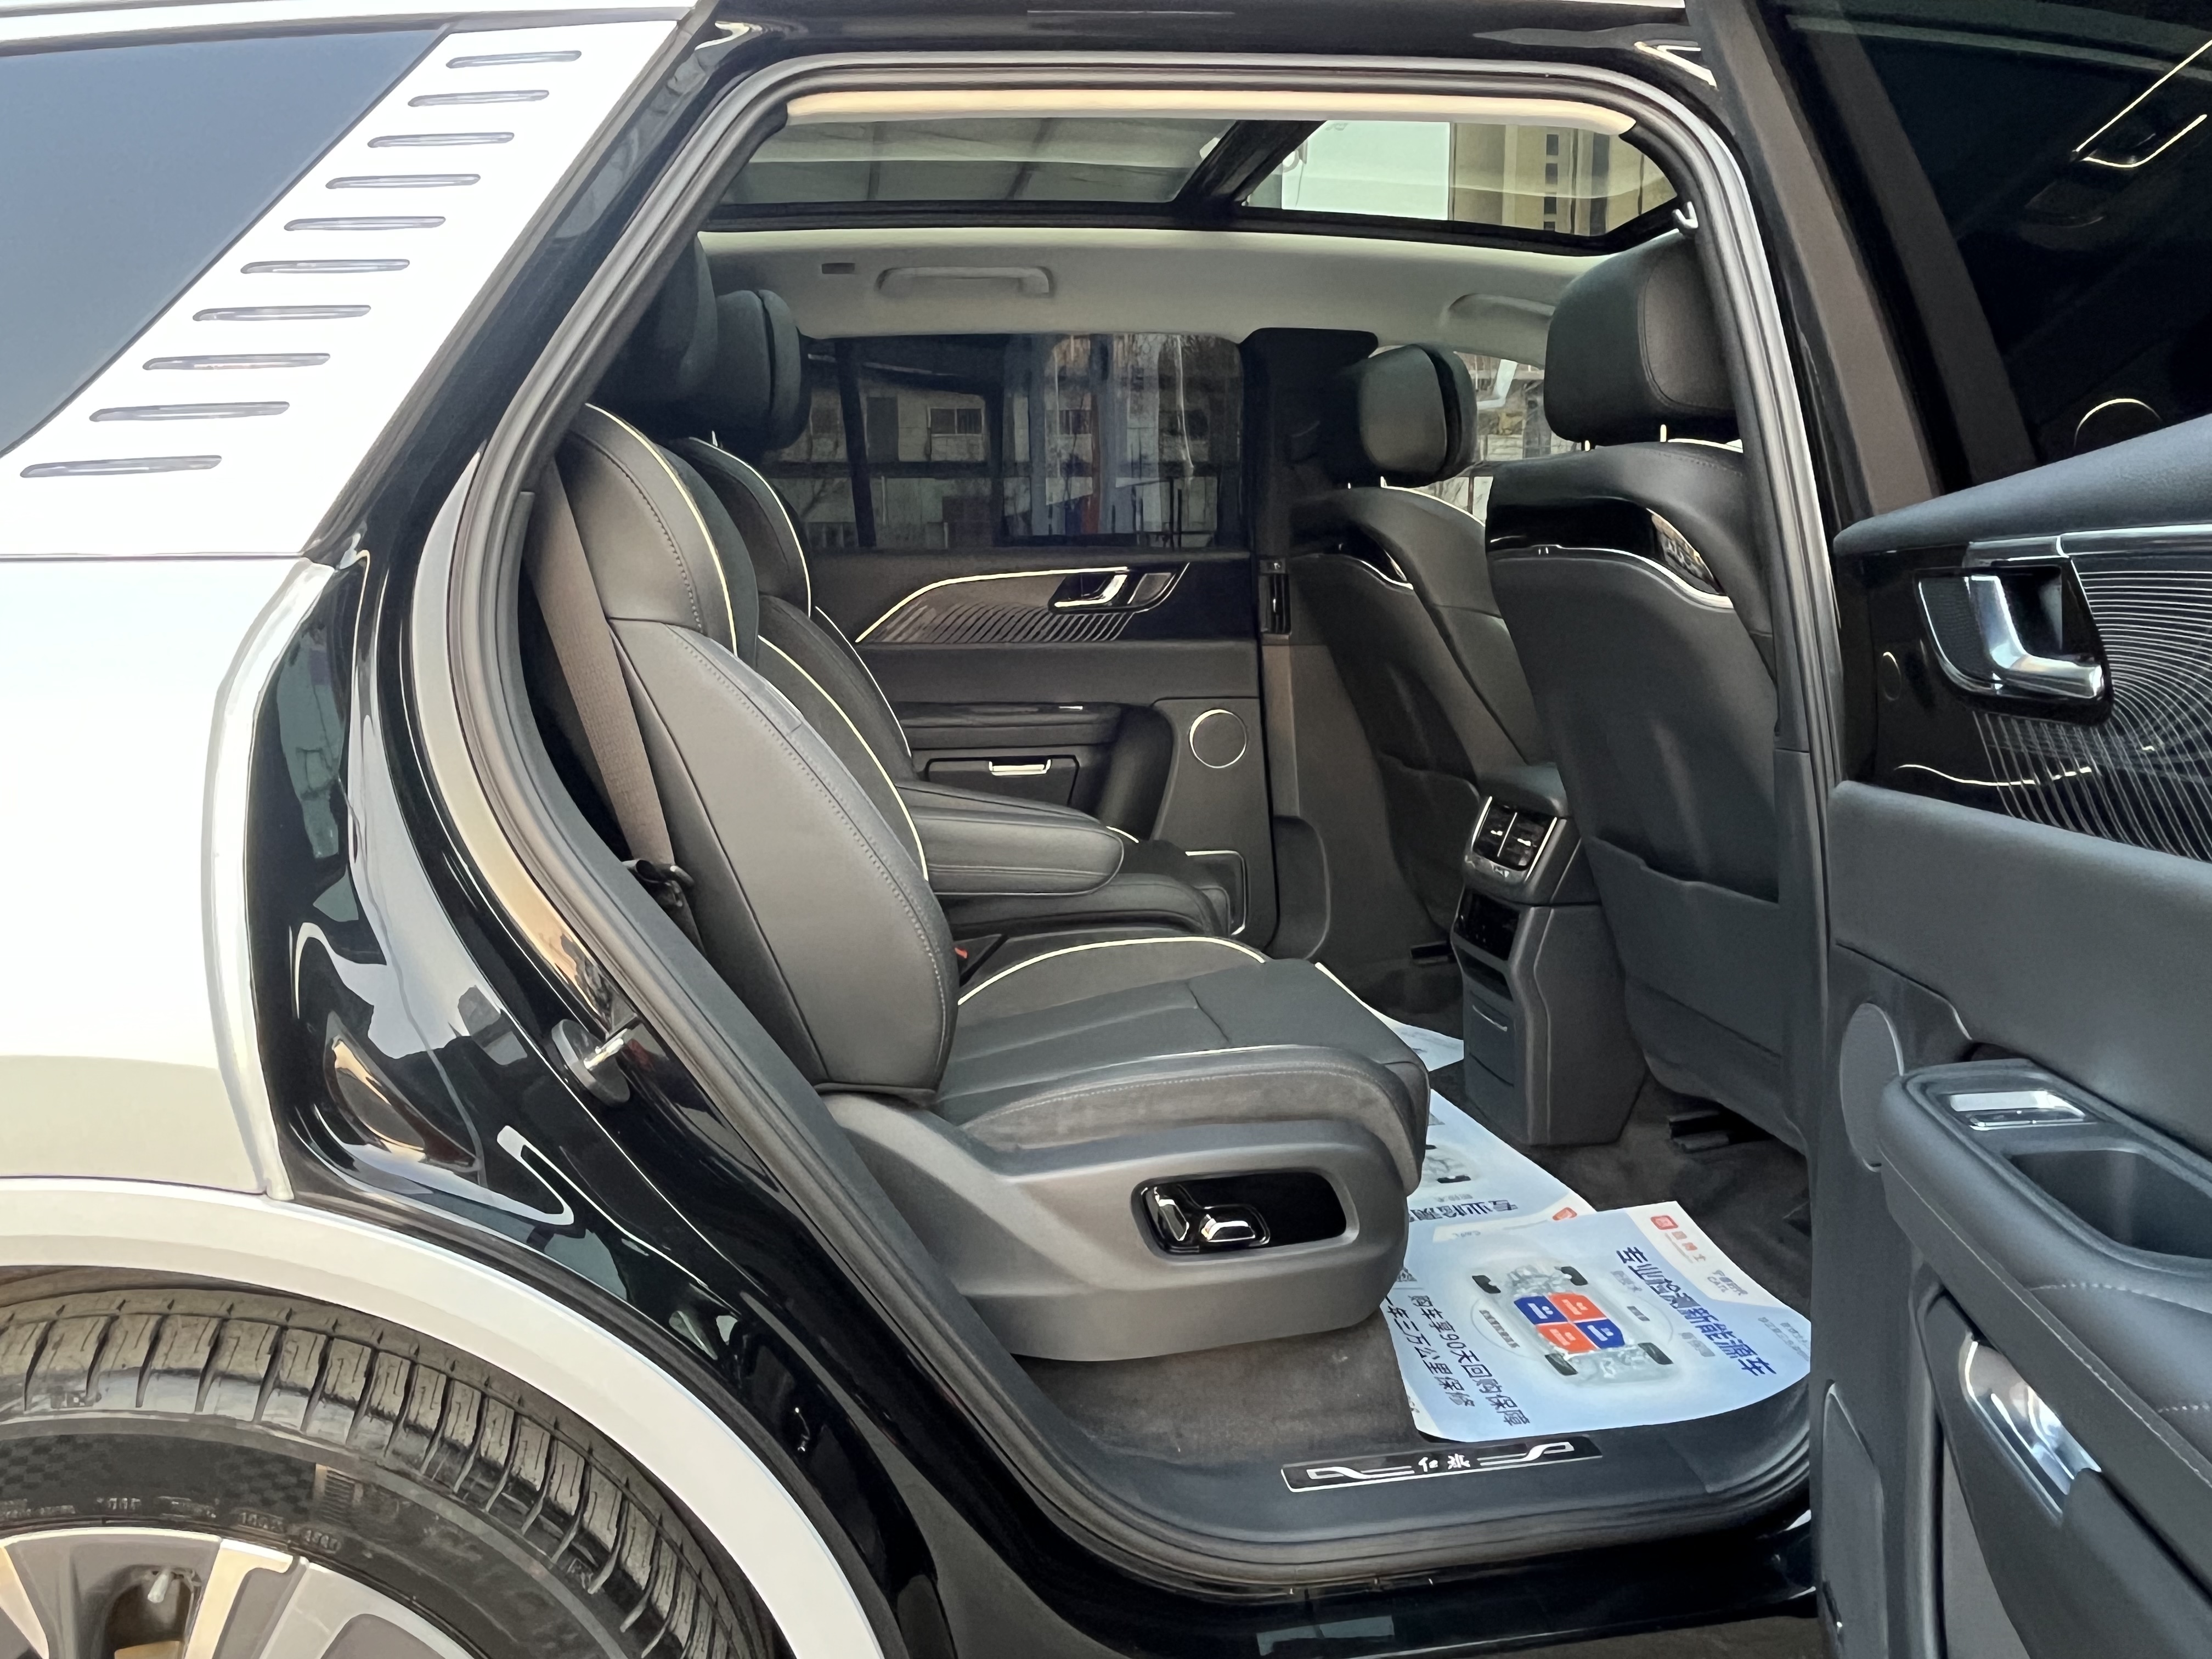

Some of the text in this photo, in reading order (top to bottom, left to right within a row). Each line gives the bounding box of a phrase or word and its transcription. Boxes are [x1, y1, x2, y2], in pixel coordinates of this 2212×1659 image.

[1407, 1295, 1531, 1426] 购车享90天回购保障
[1616, 1246, 1776, 1376] 专业检测新能源车
